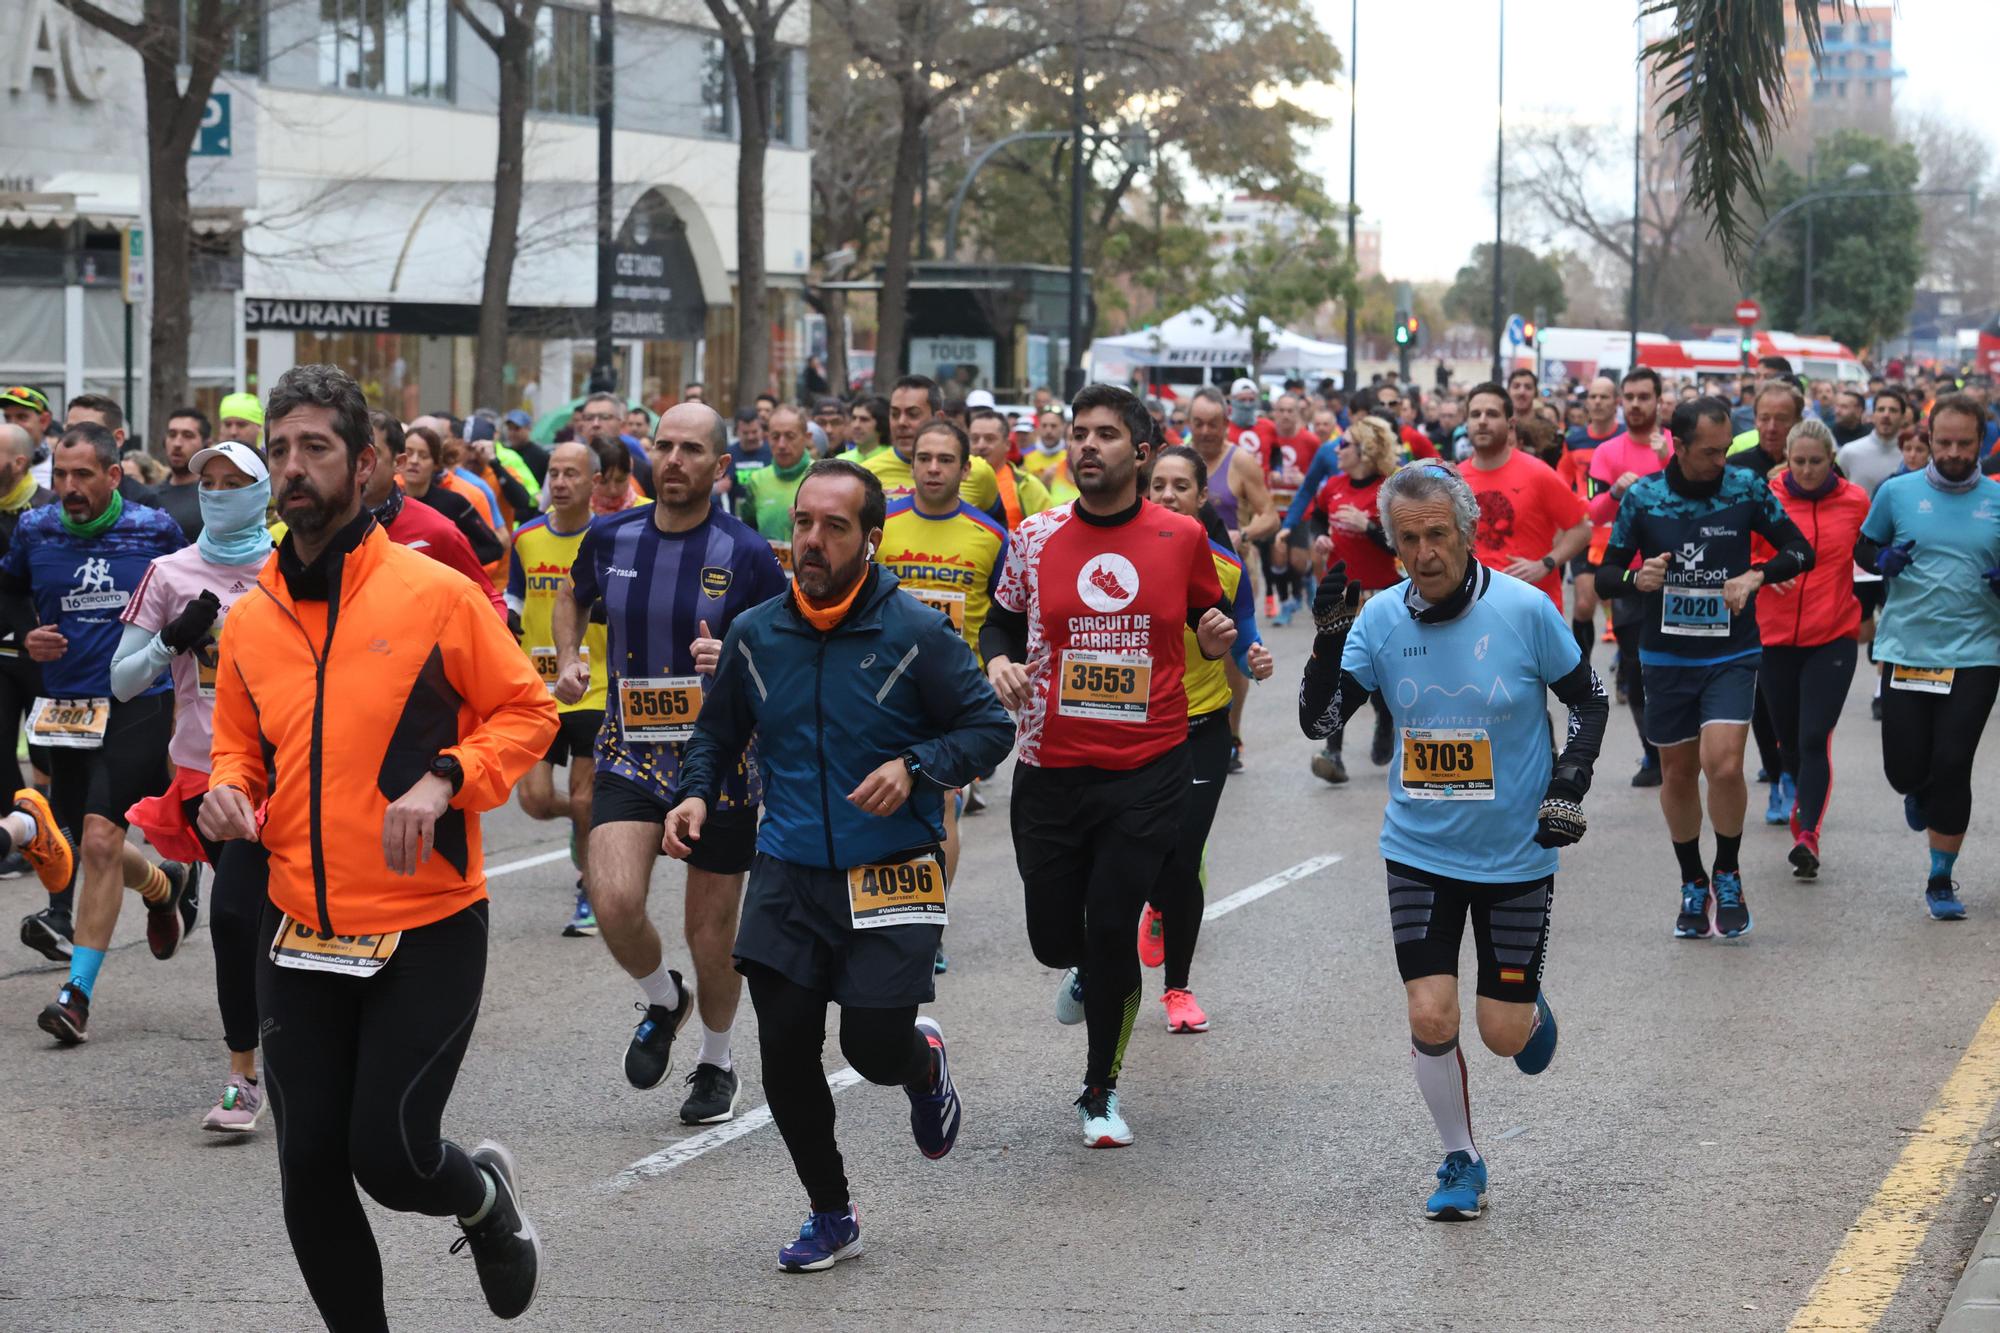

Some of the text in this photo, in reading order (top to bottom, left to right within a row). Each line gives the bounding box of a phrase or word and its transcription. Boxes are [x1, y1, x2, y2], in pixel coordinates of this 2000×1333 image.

[929, 343, 976, 360] TOUS
[1664, 567, 1729, 583] linicFoot
[66, 599, 80, 608] 16
[81, 594, 121, 603] CIRCUITO
[1672, 596, 1718, 617] 2020
[1068, 615, 1151, 632] CIRCUIT DE
[1071, 631, 1150, 648] CARRERES
[1403, 646, 1427, 657] GOBIK
[538, 656, 557, 675] 35
[1071, 664, 1136, 694] 3553
[629, 690, 689, 716] 3565
[1414, 742, 1474, 771] 3703
[861, 863, 933, 897] 4096
